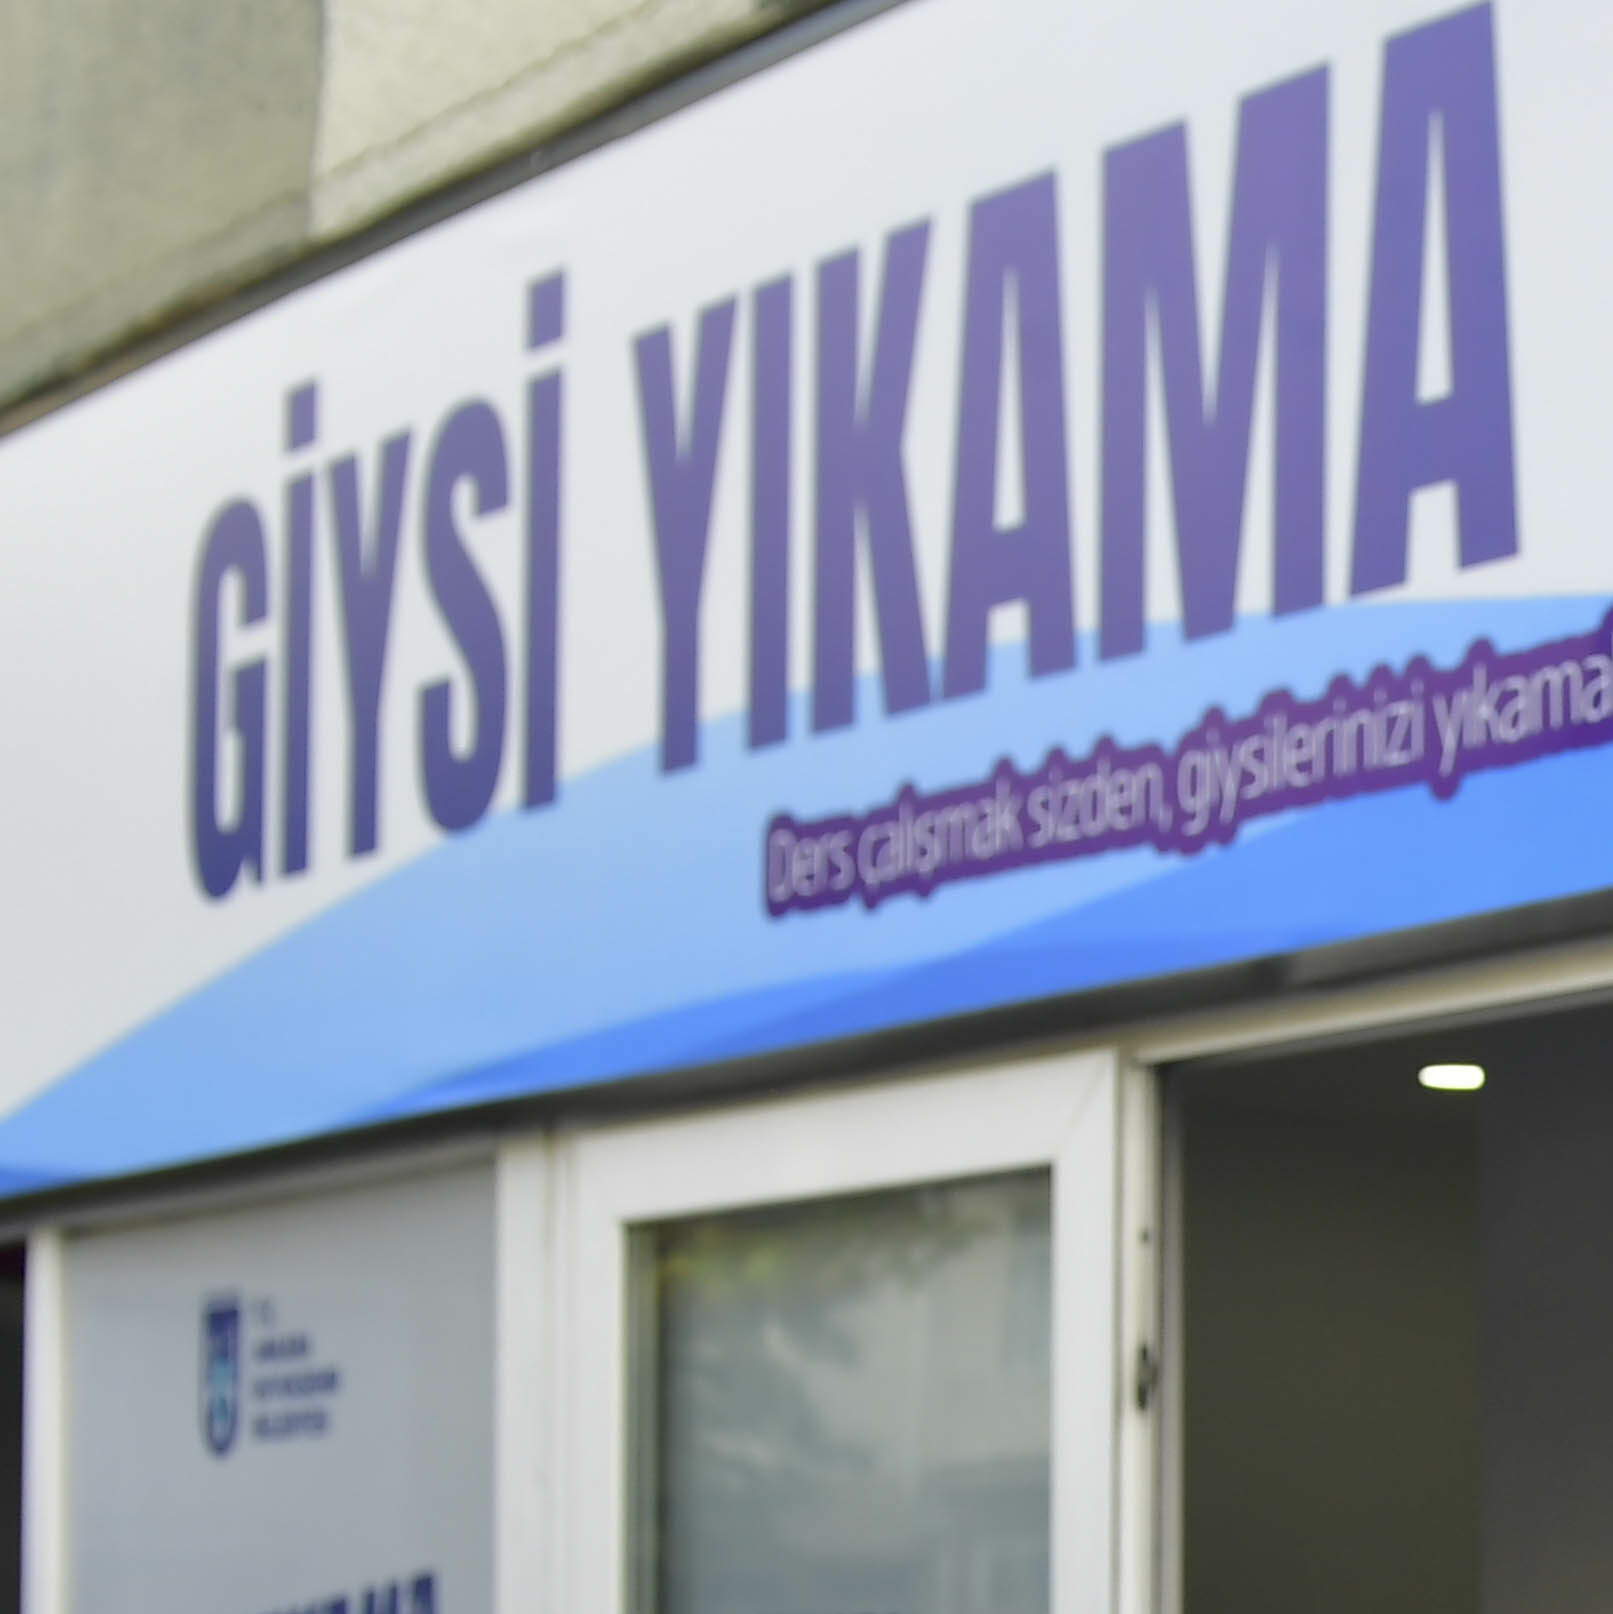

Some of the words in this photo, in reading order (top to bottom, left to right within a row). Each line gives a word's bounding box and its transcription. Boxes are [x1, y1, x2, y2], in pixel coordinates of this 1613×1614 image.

[187, 268, 566, 904] GİYSİ
[632, 0, 1519, 777] YIKAMA
[768, 828, 856, 903] Ders
[1026, 760, 1173, 848] sizden,
[1177, 681, 1426, 836] giysilerinizi
